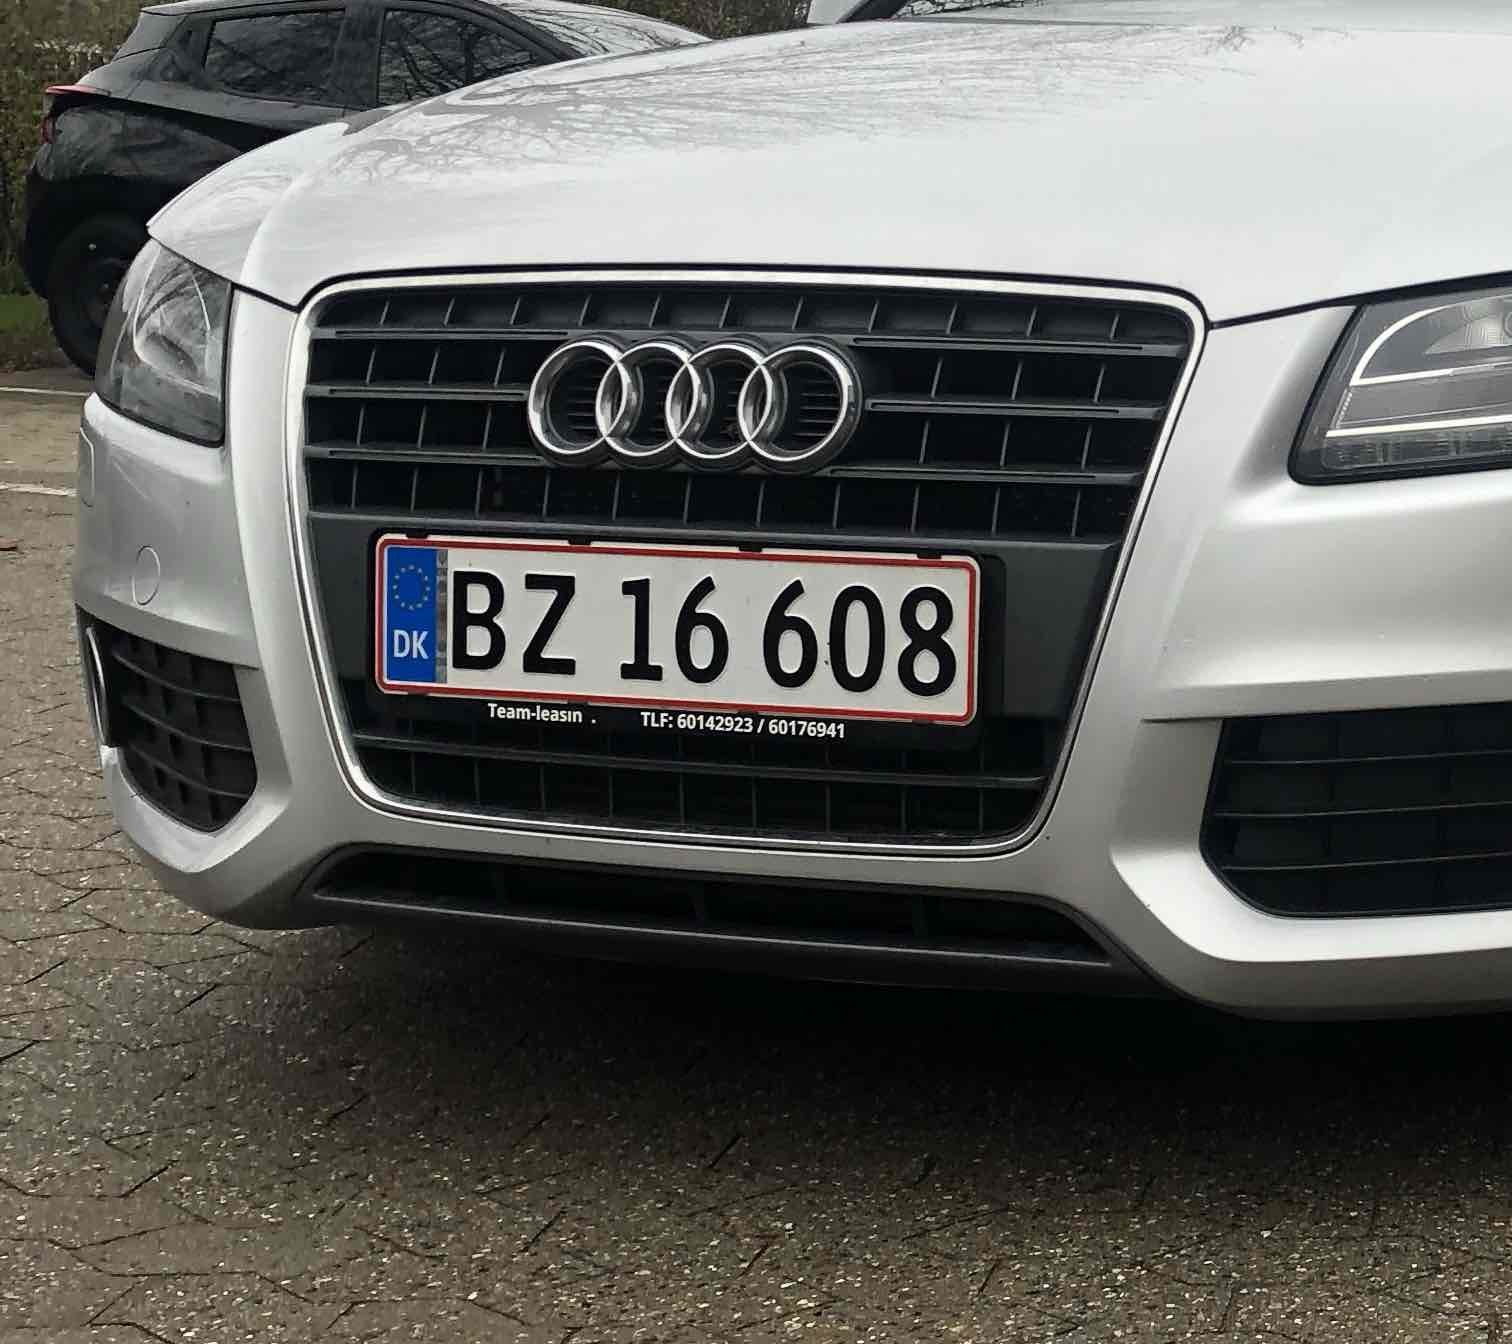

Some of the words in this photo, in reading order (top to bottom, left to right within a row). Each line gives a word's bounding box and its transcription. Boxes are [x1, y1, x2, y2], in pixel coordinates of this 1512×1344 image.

[393, 629, 429, 660] DK
[451, 570, 577, 676] BZ
[620, 575, 730, 685] 16
[762, 579, 957, 698] 608
[640, 711, 674, 729] TLF:
[677, 713, 754, 733] 60142923
[768, 718, 845, 739] 60176941
